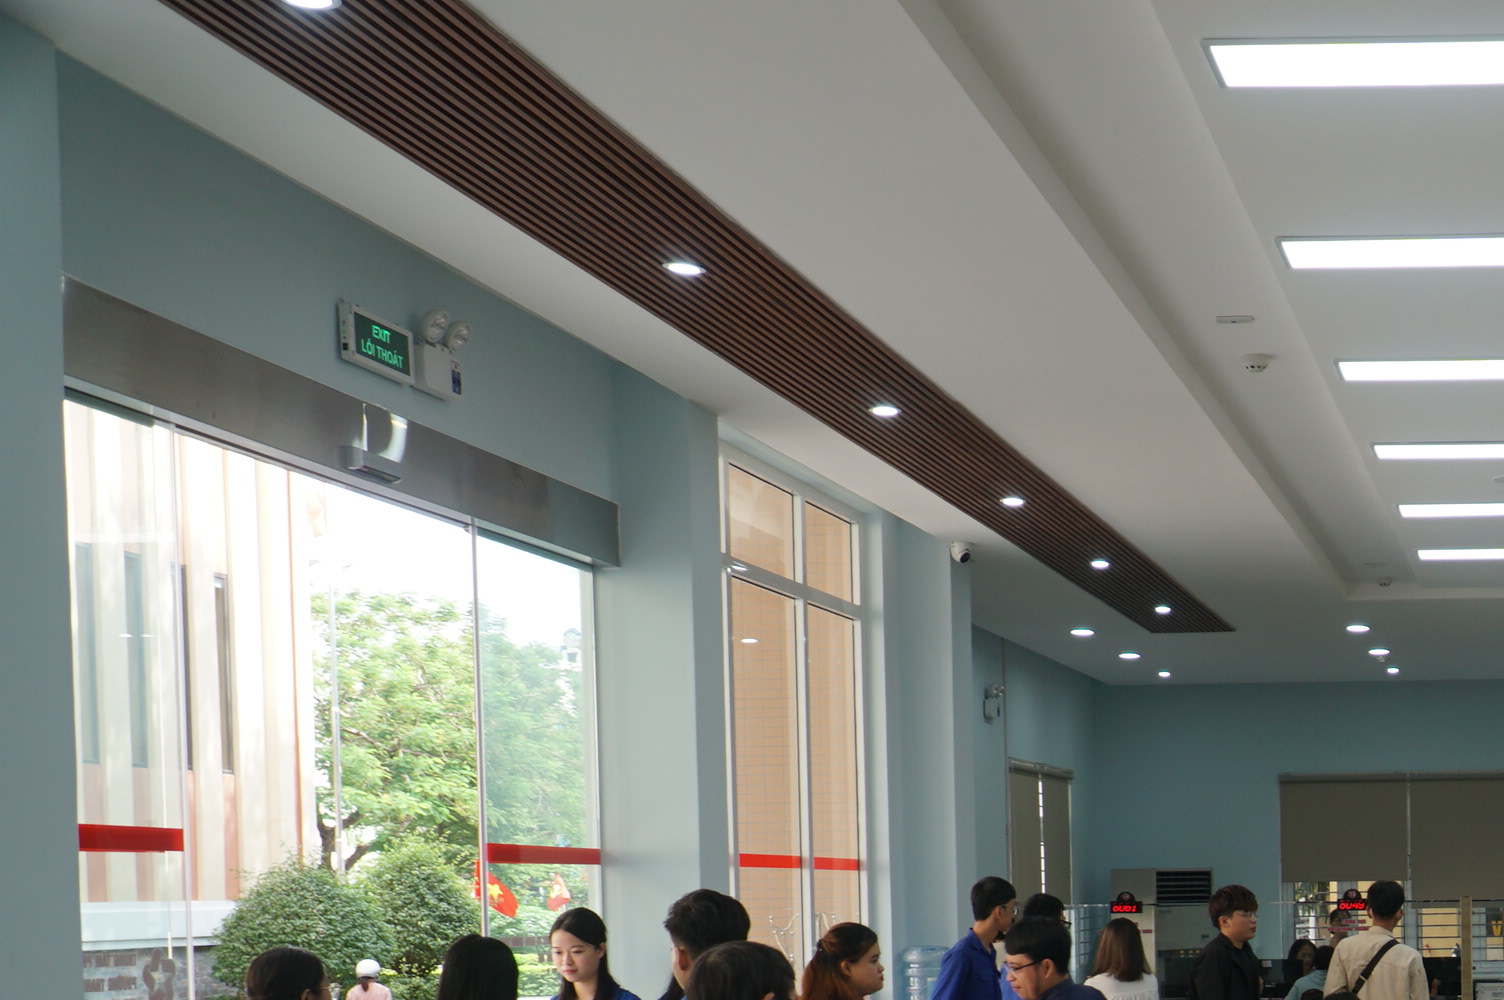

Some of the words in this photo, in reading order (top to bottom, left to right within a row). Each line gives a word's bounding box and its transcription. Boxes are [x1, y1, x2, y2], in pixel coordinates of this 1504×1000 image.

[372, 324, 391, 343] EXIT
[361, 338, 376, 356] LỐI
[376, 346, 403, 368] THOÁT
